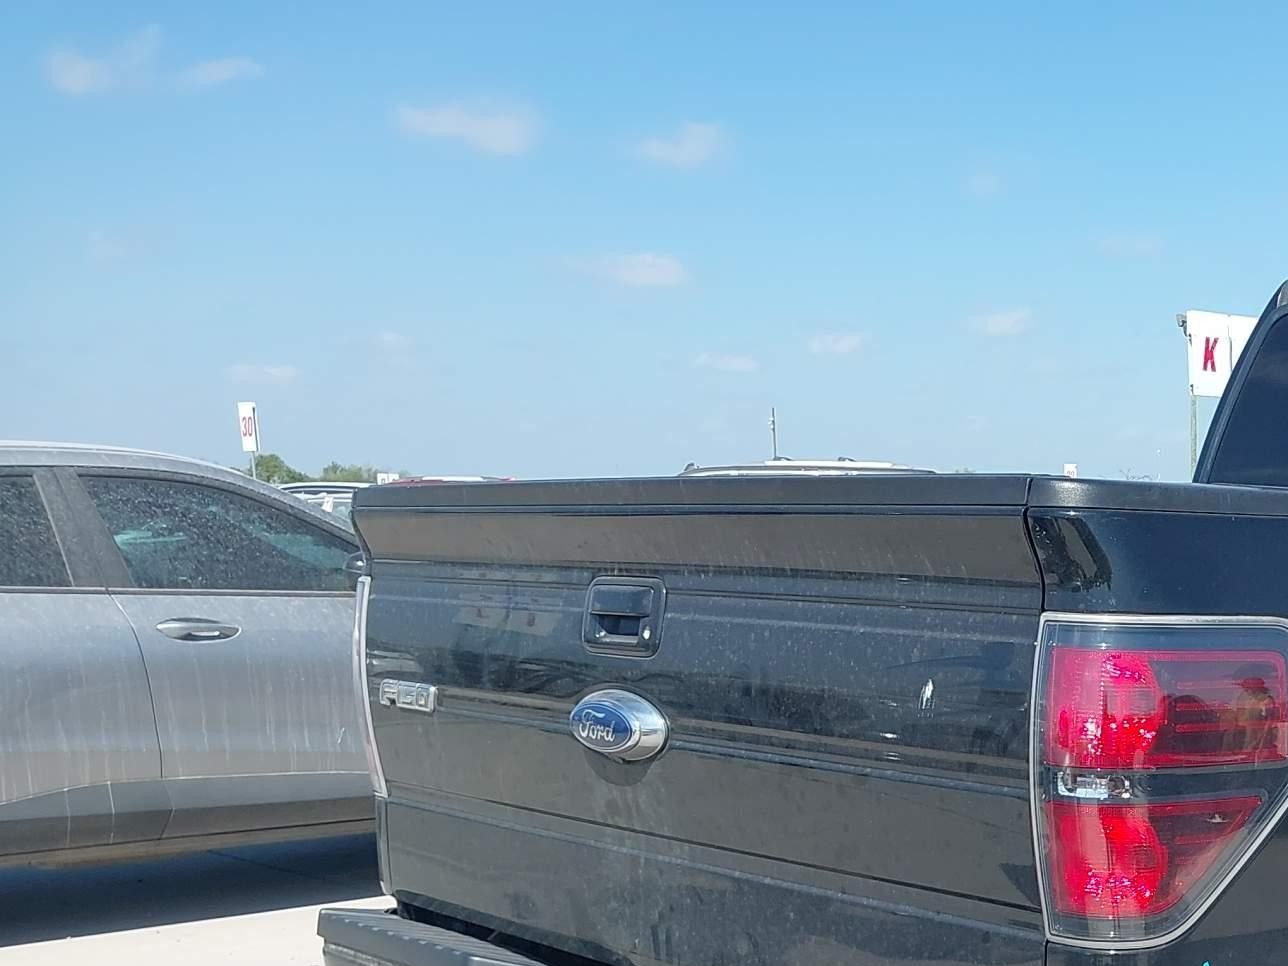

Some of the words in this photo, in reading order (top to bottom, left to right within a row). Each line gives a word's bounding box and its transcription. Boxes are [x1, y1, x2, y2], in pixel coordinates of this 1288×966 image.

[1203, 336, 1219, 372] K
[241, 416, 253, 437] 30
[579, 709, 616, 742] Ford
